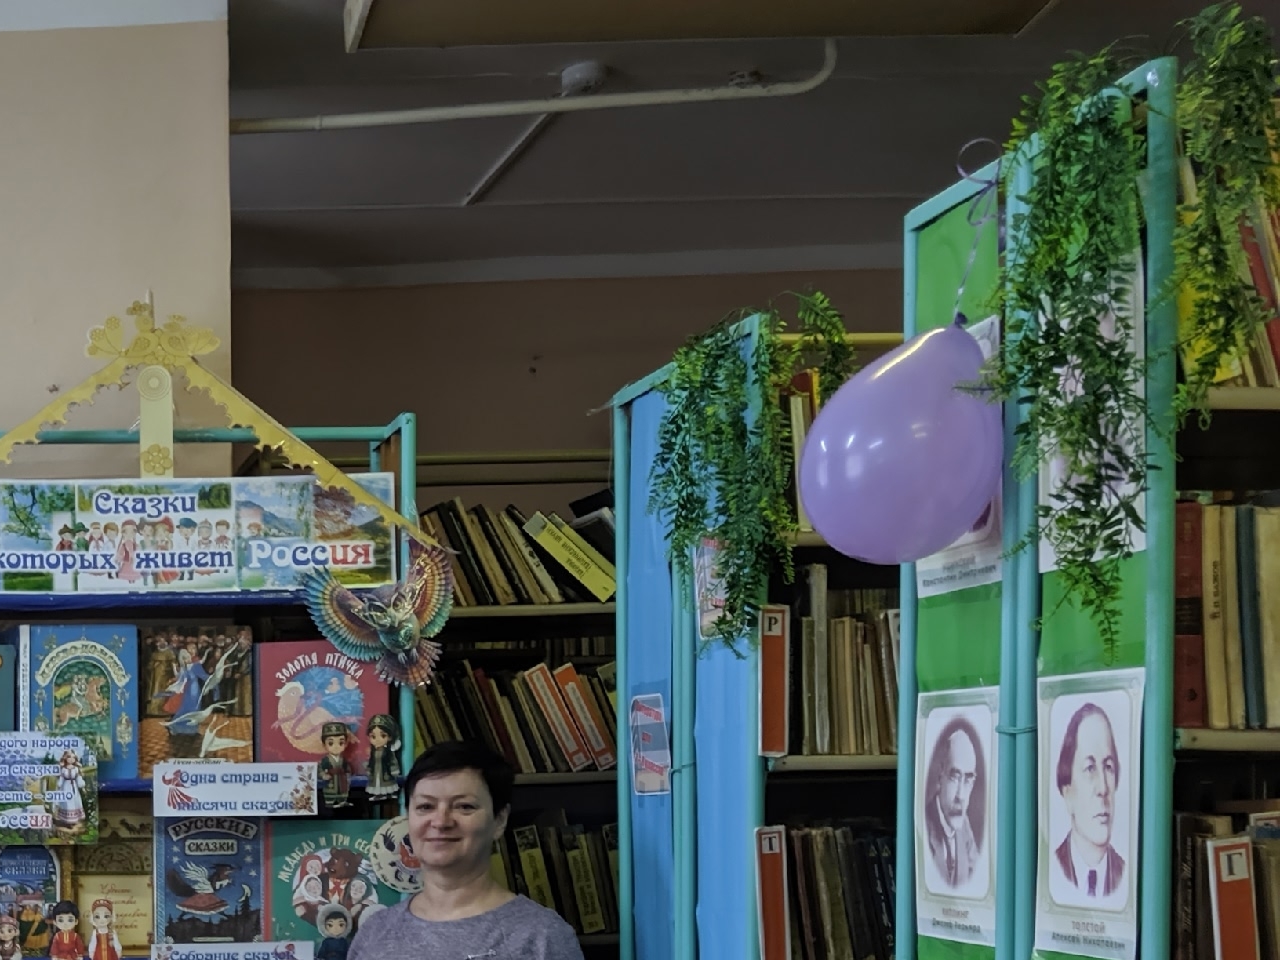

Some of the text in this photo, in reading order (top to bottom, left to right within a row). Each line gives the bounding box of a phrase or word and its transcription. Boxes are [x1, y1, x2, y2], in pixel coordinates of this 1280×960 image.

[95, 492, 196, 519] Сказки
[135, 548, 233, 570] живет
[767, 617, 779, 633] Р
[275, 652, 364, 683] ЗОЛОТАЯ ПТИЧКА
[31, 738, 79, 749] народа
[12, 765, 60, 776] сказка
[180, 771, 279, 787] Одна страна
[241, 801, 295, 813] сказок
[172, 817, 255, 839] РУССКИЕ
[187, 841, 235, 852] СКАЗКИ
[766, 836, 778, 852] Т
[278, 839, 316, 882] МЕДВЕДЬ
[331, 833, 350, 846] ТРИ
[354, 836, 371, 854] СЕС
[1225, 853, 1242, 876] Г
[1072, 920, 1105, 933] ТОЛСТОЙ
[1052, 931, 1080, 944] Алексей
